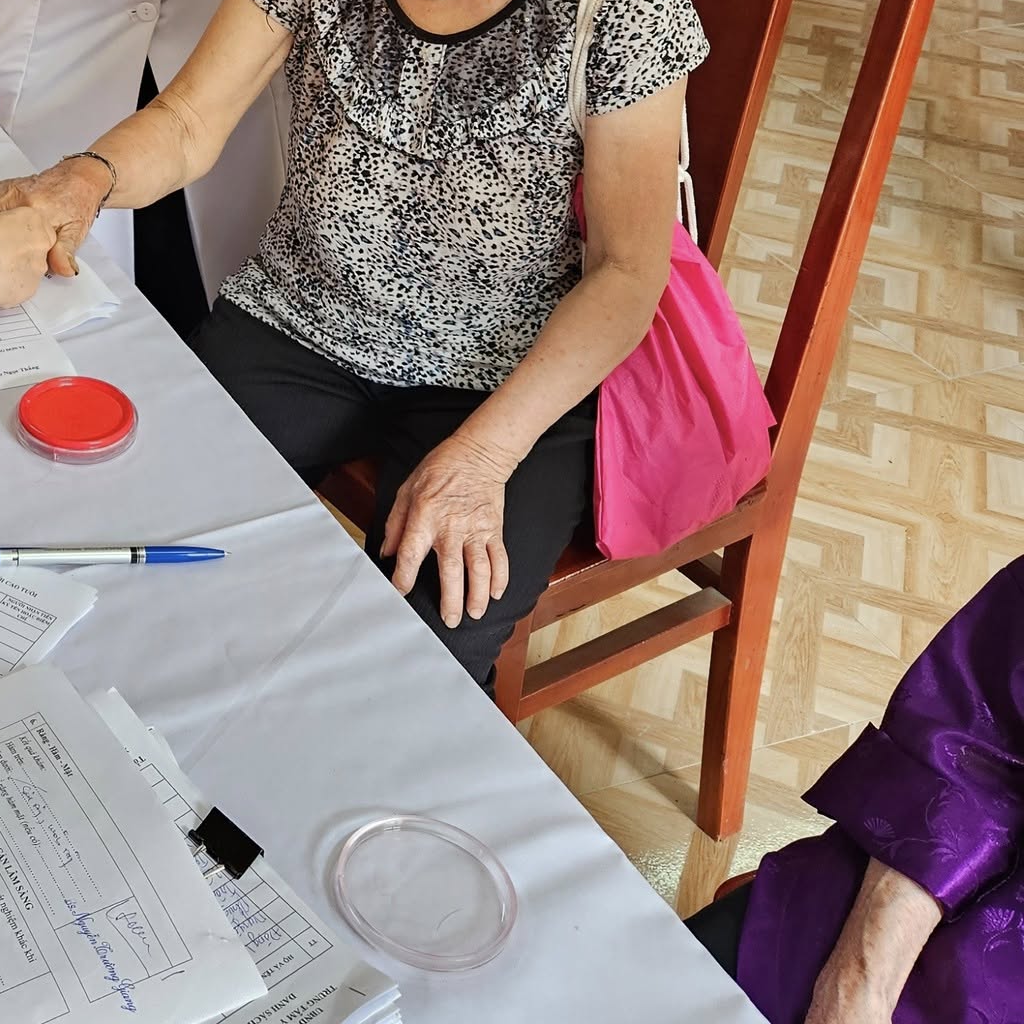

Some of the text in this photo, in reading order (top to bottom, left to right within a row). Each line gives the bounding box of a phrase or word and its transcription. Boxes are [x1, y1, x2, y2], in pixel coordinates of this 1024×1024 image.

[36, 728, 50, 744] Răng
[4, 865, 20, 885] LÂM
[15, 885, 34, 910] SÀNG
[0, 902, 18, 930] nghiệm
[14, 929, 28, 949] khác
[24, 948, 37, 963] khi
[274, 992, 297, 1011] DANH
[307, 985, 338, 1007] TRUNG
[288, 1003, 307, 1020] TÂM
[298, 1007, 324, 1024] UBND
